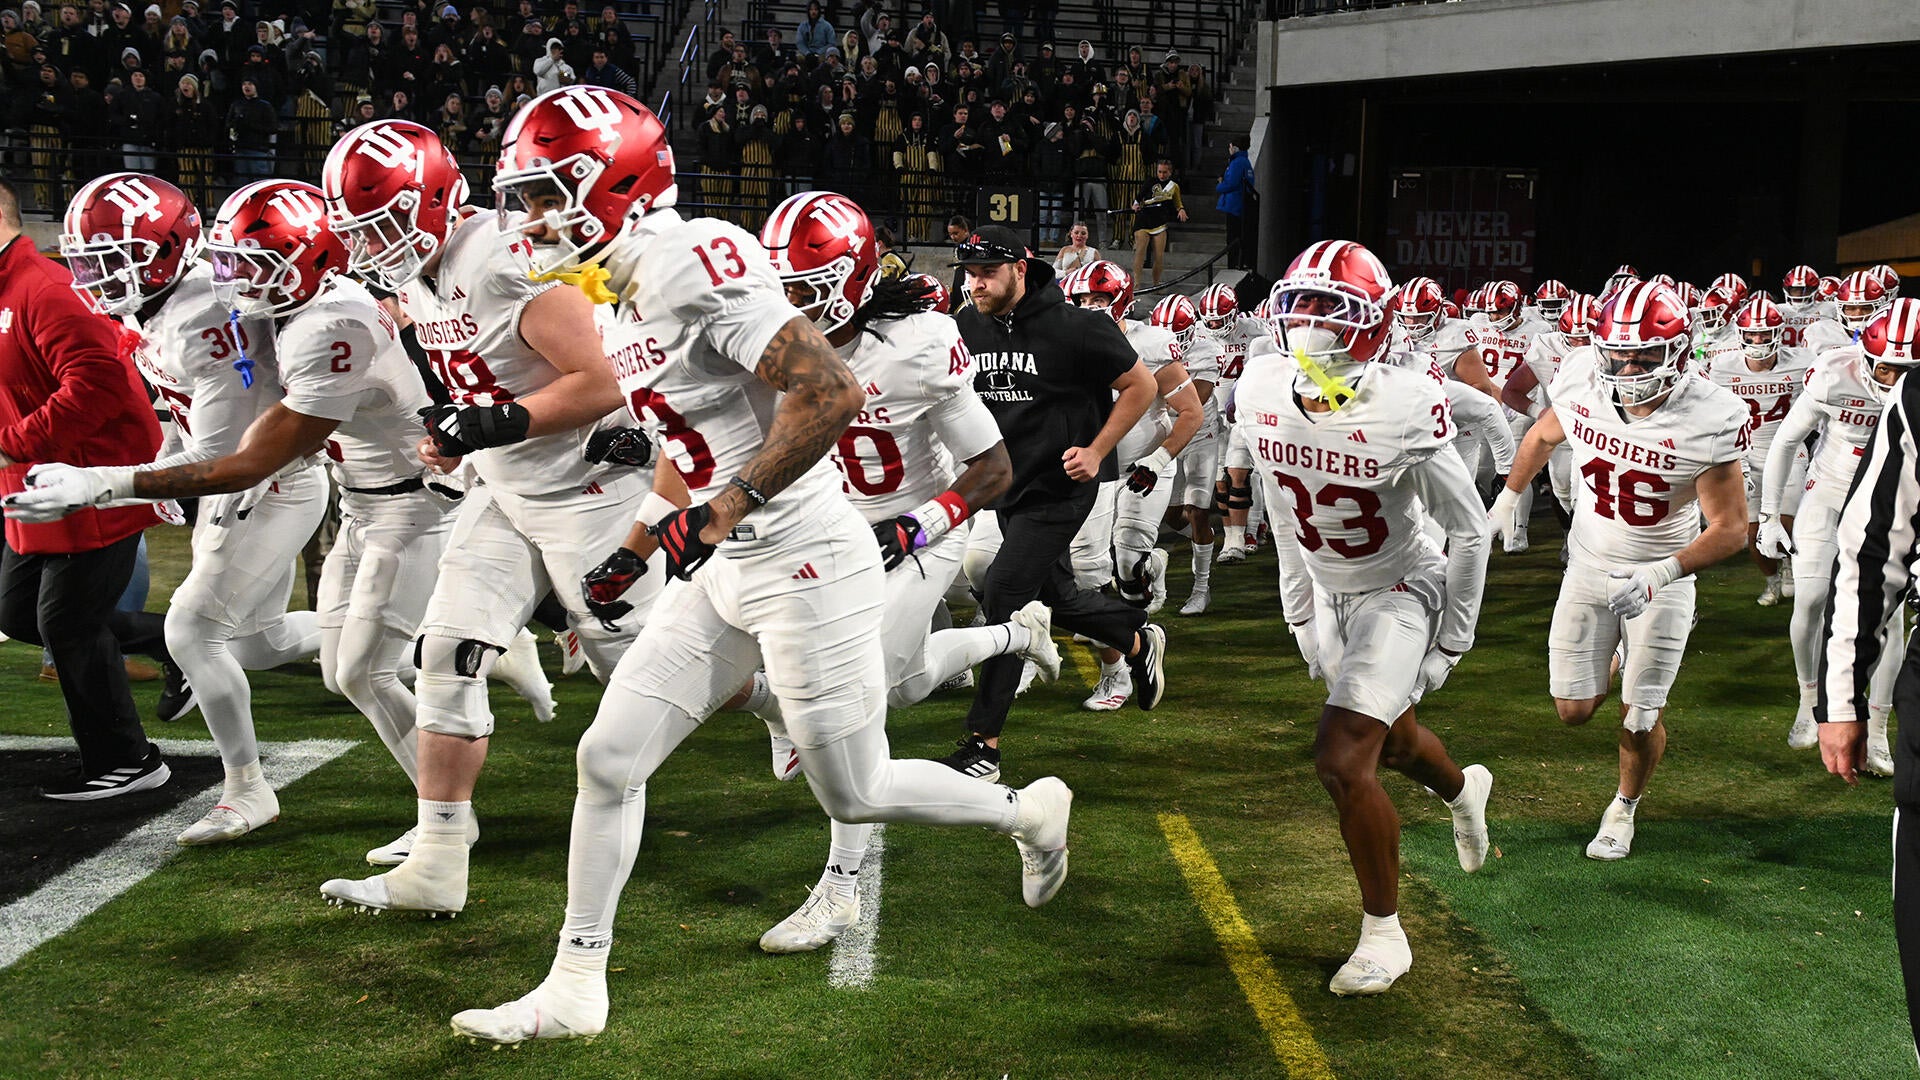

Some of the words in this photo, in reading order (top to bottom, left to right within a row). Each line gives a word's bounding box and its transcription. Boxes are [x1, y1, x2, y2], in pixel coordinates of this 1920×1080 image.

[989, 193, 1019, 223] 31
[1416, 210, 1510, 237] NEVER
[692, 236, 747, 287] 13
[1396, 239, 1529, 268] DAUNTED
[201, 320, 249, 360] 30
[413, 313, 479, 345] OOSIERS
[1464, 328, 1479, 343] 61
[1481, 336, 1526, 349] HOOERS
[331, 341, 351, 374] 2
[607, 336, 667, 381] OSIERS
[948, 337, 971, 376] 40
[972, 351, 1039, 376] NDIANA
[1482, 348, 1525, 380] 97
[1732, 382, 1795, 396] HOOSIERS
[1256, 411, 1279, 428] B1G
[829, 425, 905, 497] 0
[1257, 437, 1380, 479] HOOSIERS
[1573, 419, 1677, 471] HOOSIERS
[1580, 456, 1671, 527] 46
[1272, 470, 1390, 560] 33
